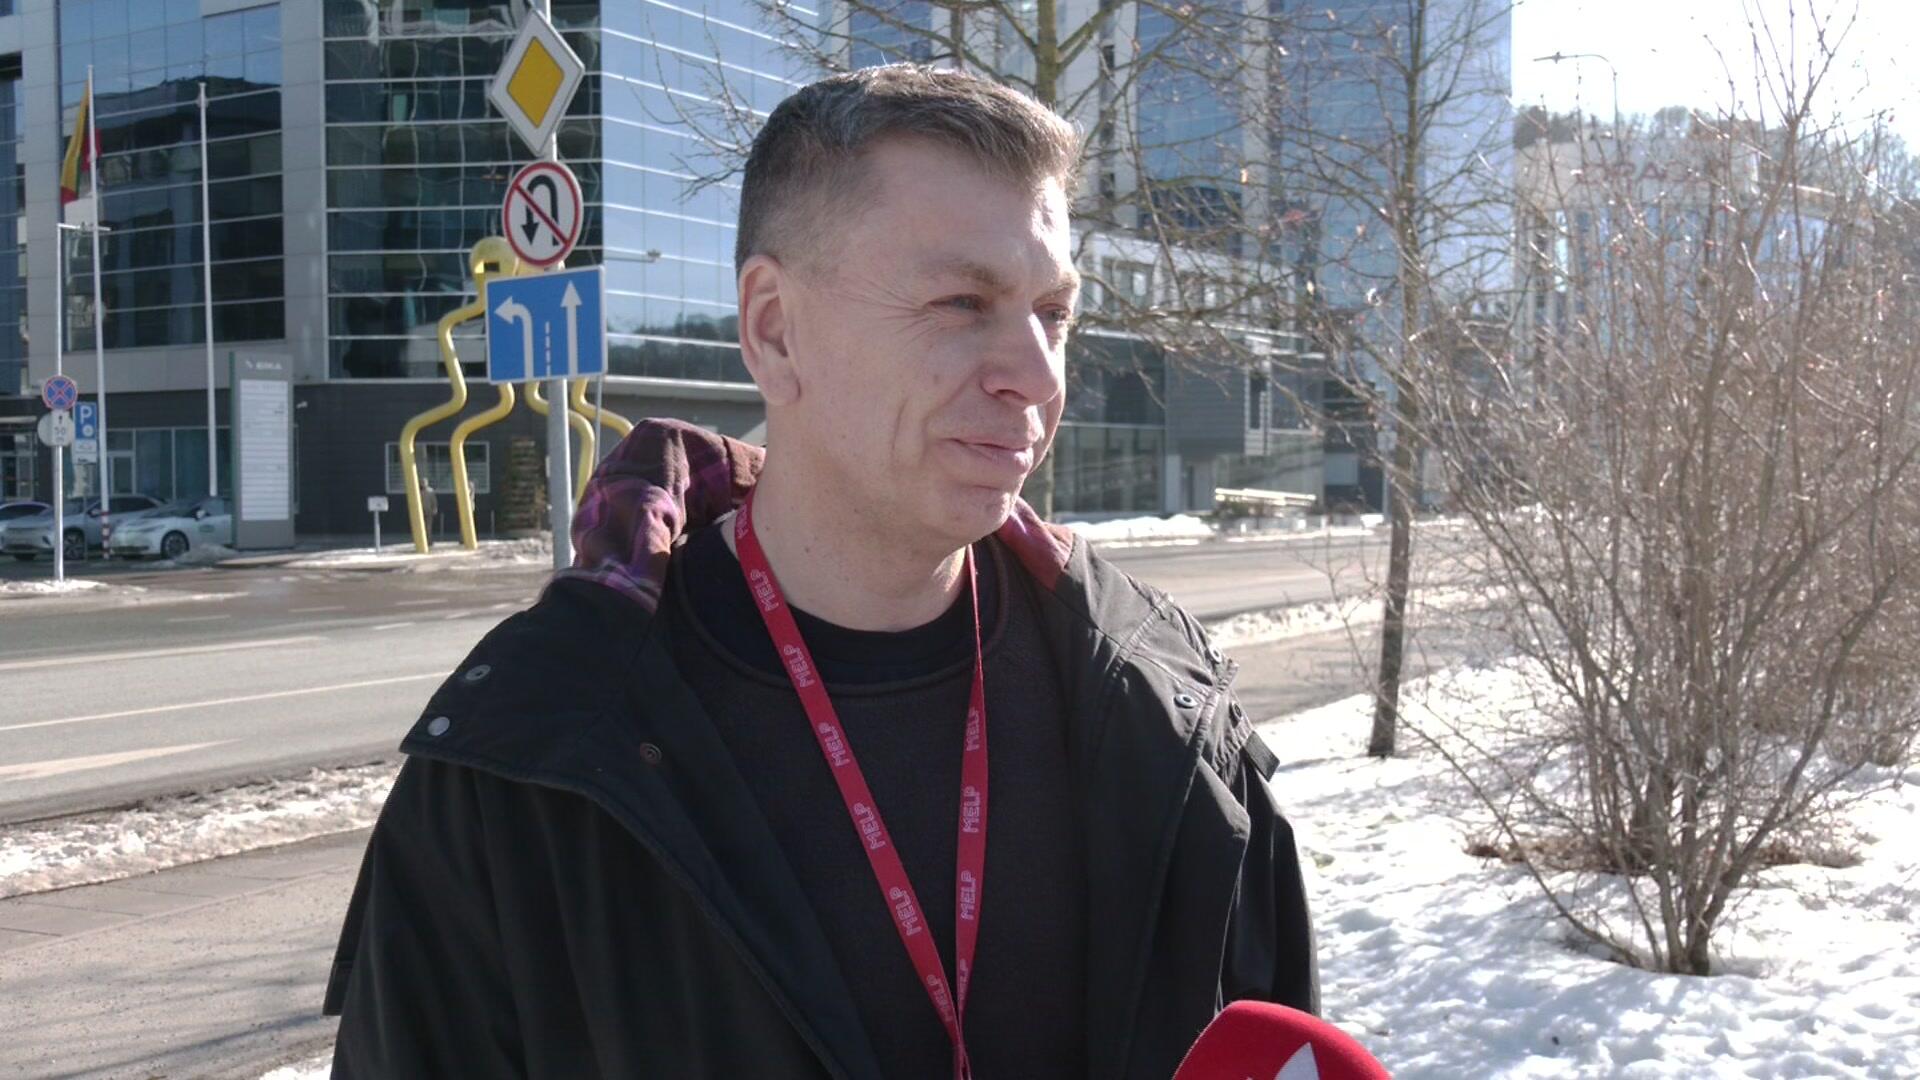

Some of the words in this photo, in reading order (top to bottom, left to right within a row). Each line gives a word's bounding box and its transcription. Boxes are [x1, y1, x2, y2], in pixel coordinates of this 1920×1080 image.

[79, 405, 93, 425] P
[750, 568, 779, 612] MELP
[783, 644, 815, 688] MELP
[818, 722, 850, 767] MELP
[966, 706, 980, 751] MELP
[853, 802, 886, 850] MELP
[962, 785, 980, 833] MELP
[889, 886, 922, 936] MELP
[960, 870, 976, 920] MELP
[926, 974, 954, 1022] MELP
